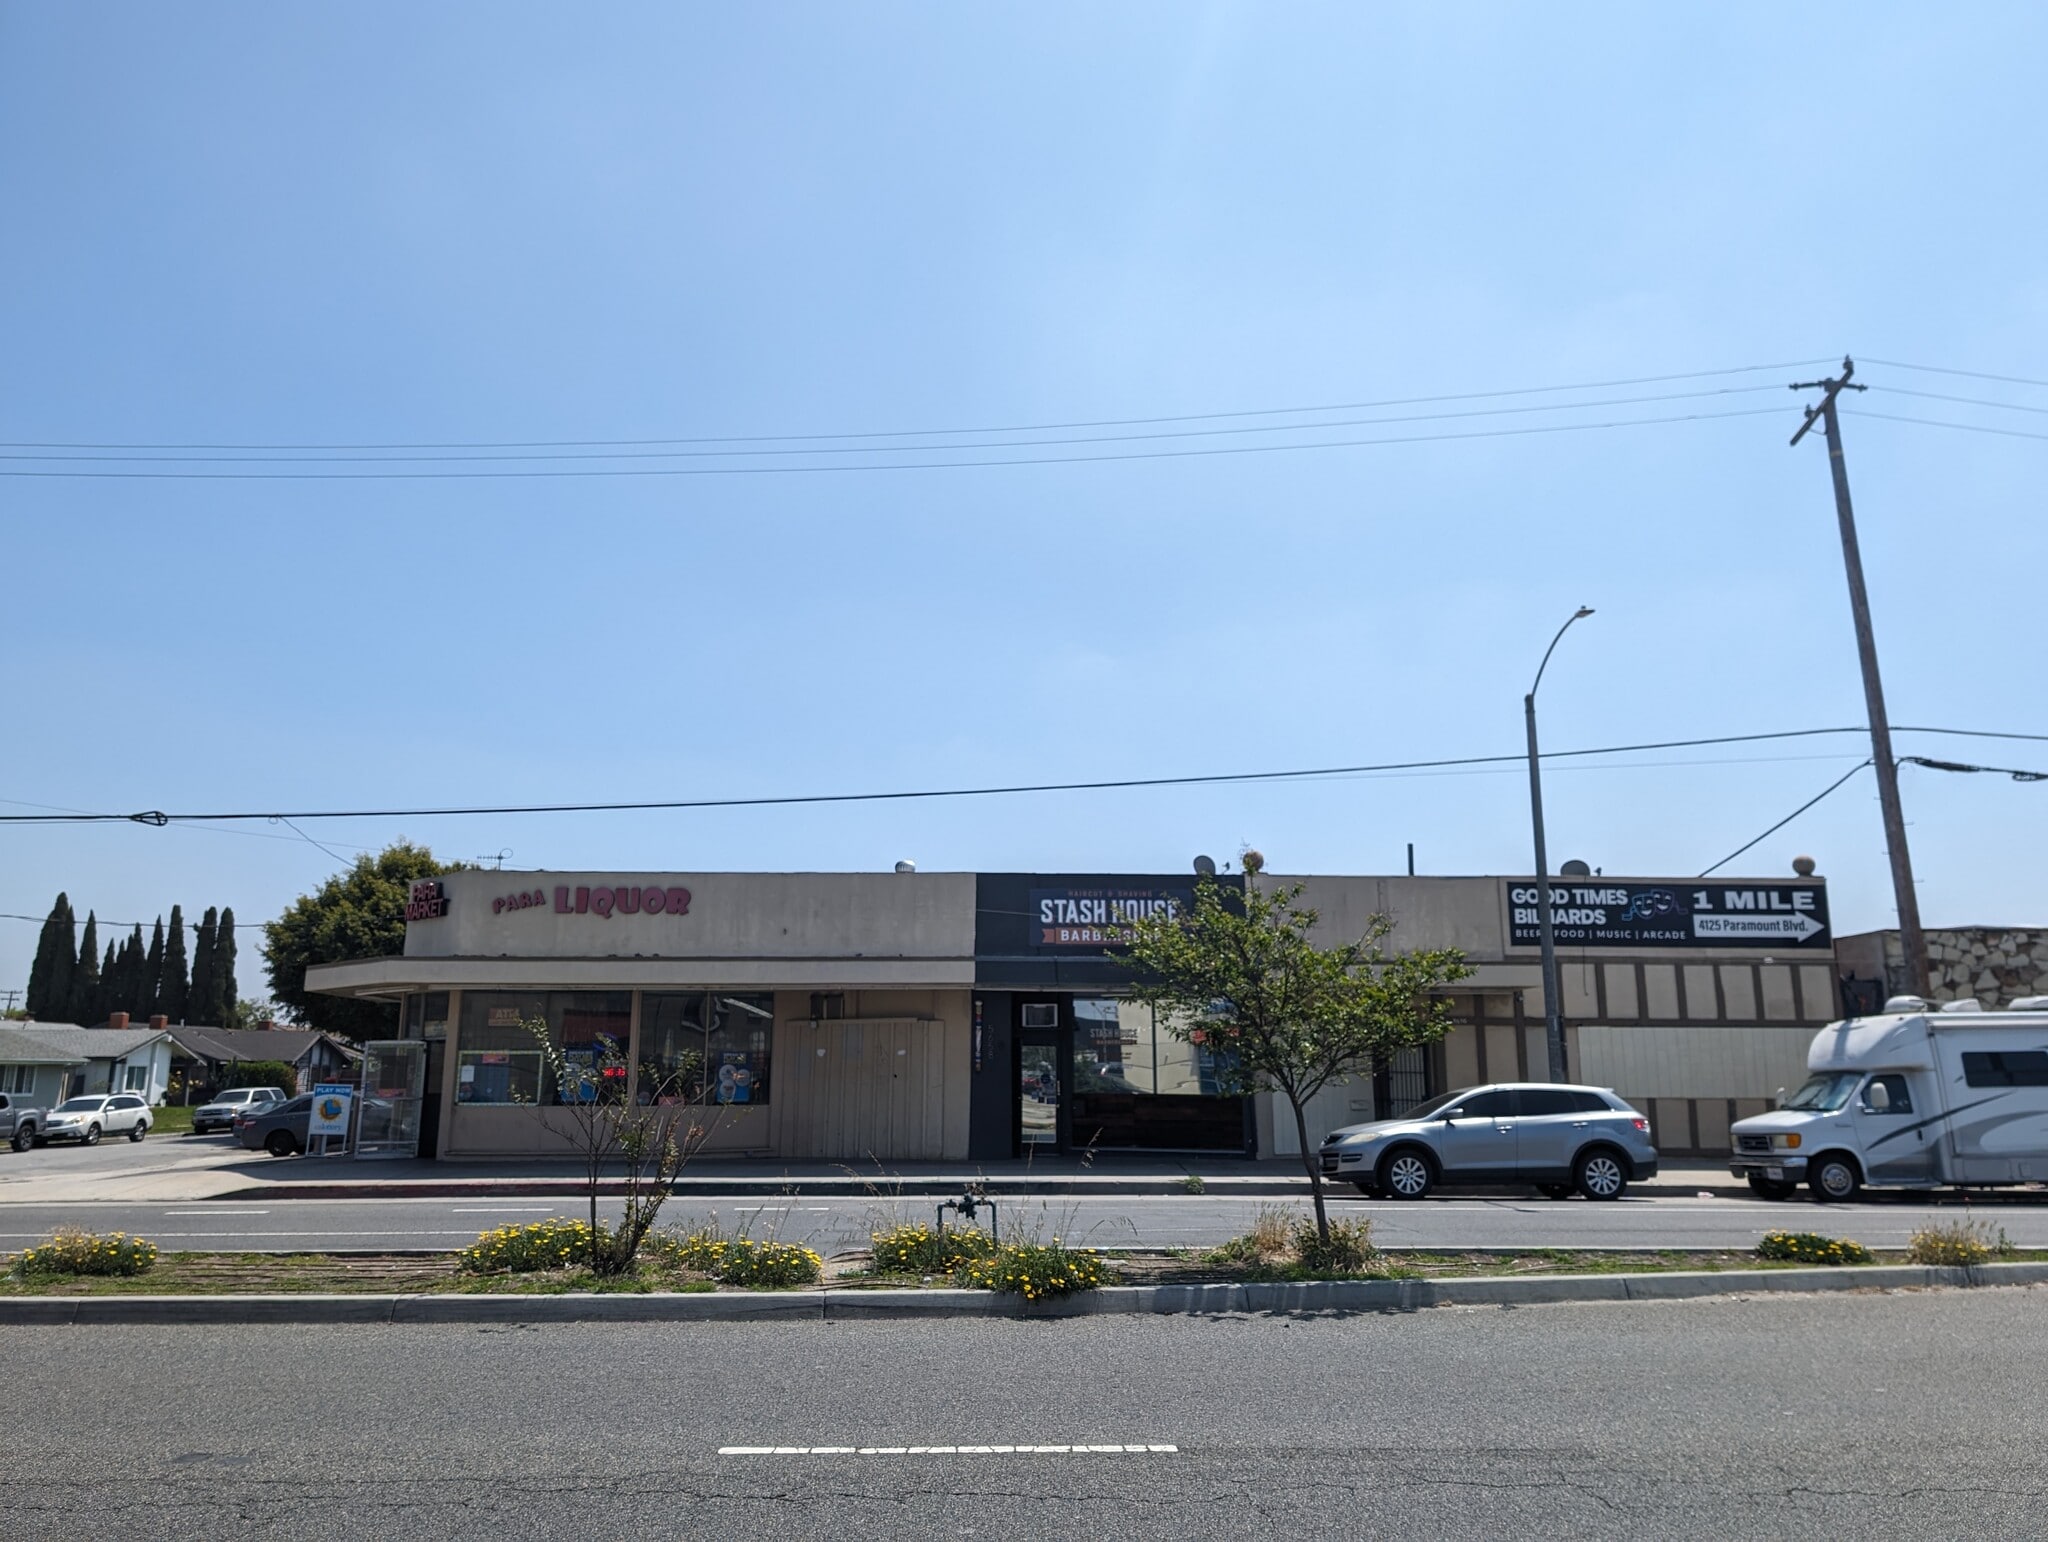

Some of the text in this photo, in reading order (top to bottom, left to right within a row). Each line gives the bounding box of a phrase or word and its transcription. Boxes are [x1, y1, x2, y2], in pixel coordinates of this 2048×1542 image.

[413, 883, 437, 899] PARA
[1068, 889, 1103, 897] HAIRCUT
[1117, 889, 1153, 897] SHAVING
[1572, 889, 1629, 905] TIMES
[492, 886, 692, 919] PARA LIQUOR
[1692, 890, 1816, 910] 1 MILE
[405, 898, 443, 921] MARKET
[1040, 899, 1106, 924] STASH
[1514, 908, 1606, 925] BILIARDS
[1698, 919, 1809, 933] 4125 Paramount Blvd.
[1554, 929, 1585, 939] FOOD
[1597, 930, 1632, 939] MUSIC
[1643, 930, 1686, 940] ARCADE
